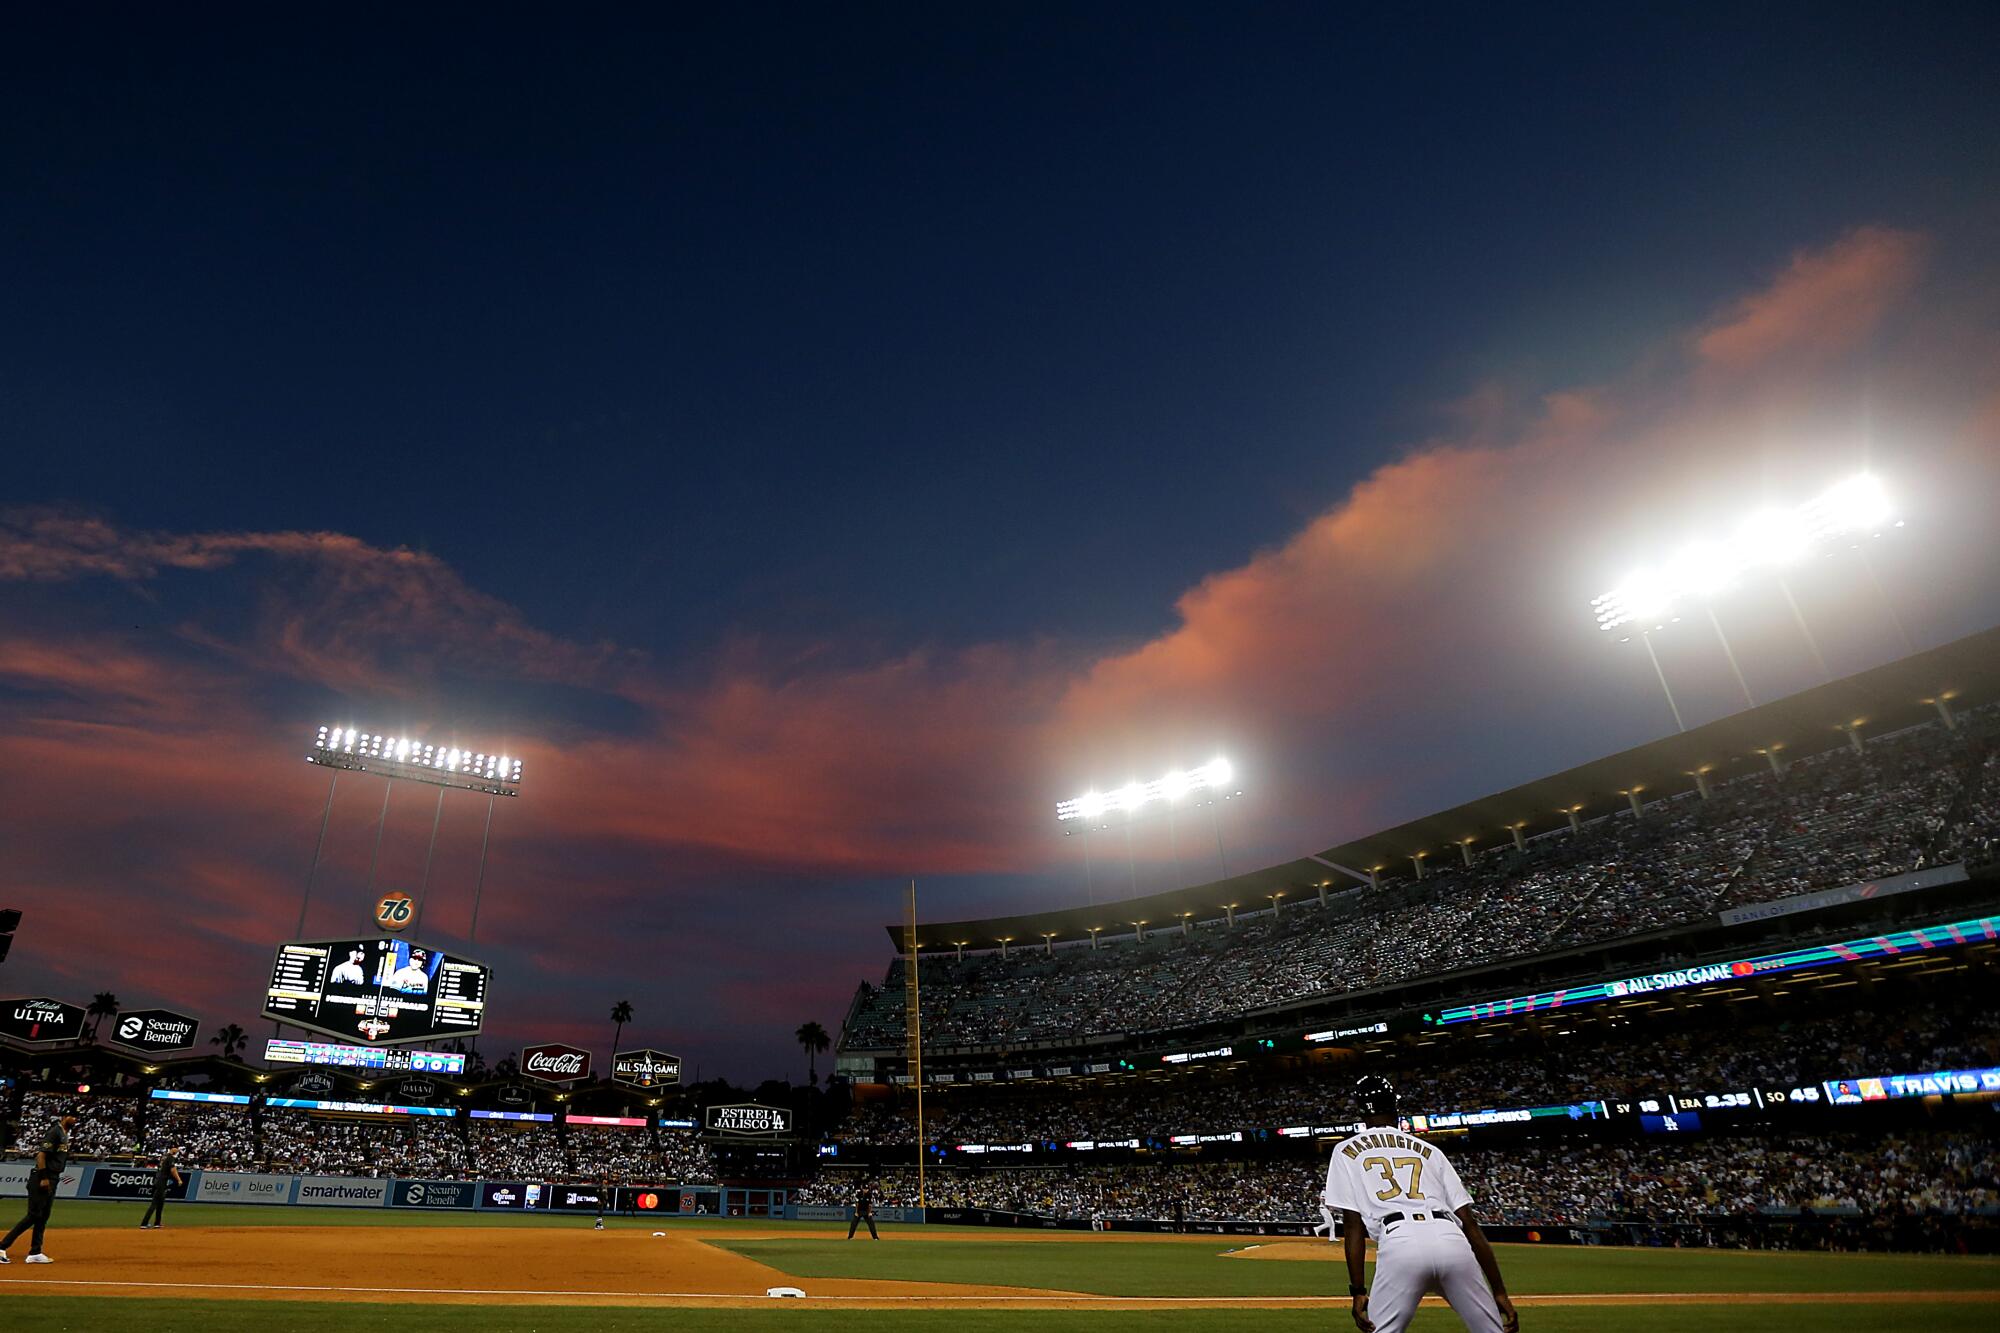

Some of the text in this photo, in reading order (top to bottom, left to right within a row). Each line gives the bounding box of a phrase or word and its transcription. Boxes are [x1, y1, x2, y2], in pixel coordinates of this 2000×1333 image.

[379, 899, 412, 921] 76
[1687, 964, 1732, 983] GAME
[14, 1008, 64, 1023] ULTRA
[147, 1018, 191, 1035] Security
[144, 1030, 183, 1044] Benefit
[527, 1052, 584, 1074] Coca-Cola
[654, 1063, 678, 1074] GAME
[300, 1076, 314, 1088] JIM
[314, 1074, 330, 1088] BEAM
[1891, 1076, 1977, 1094] TRAVIS
[1679, 1093, 1751, 1109] ERA 2.35
[1766, 1088, 1819, 1102] SO 45
[362, 1103, 383, 1113] GAME
[1617, 1100, 1660, 1113] SV 18
[714, 1118, 769, 1129] JALISCO
[1429, 1110, 1532, 1128] LIAM HENDRIKS
[1341, 1134, 1432, 1160] WASHINGTON
[109, 1173, 155, 1187] Spectru
[204, 1180, 229, 1190] blue
[1363, 1157, 1425, 1201] 37
[249, 1181, 273, 1192] blue
[302, 1184, 383, 1200] smartwater
[427, 1184, 461, 1198] Security
[426, 1194, 455, 1206] Benefit
[492, 1192, 516, 1201] Corona
[683, 1198, 692, 1206] 76
